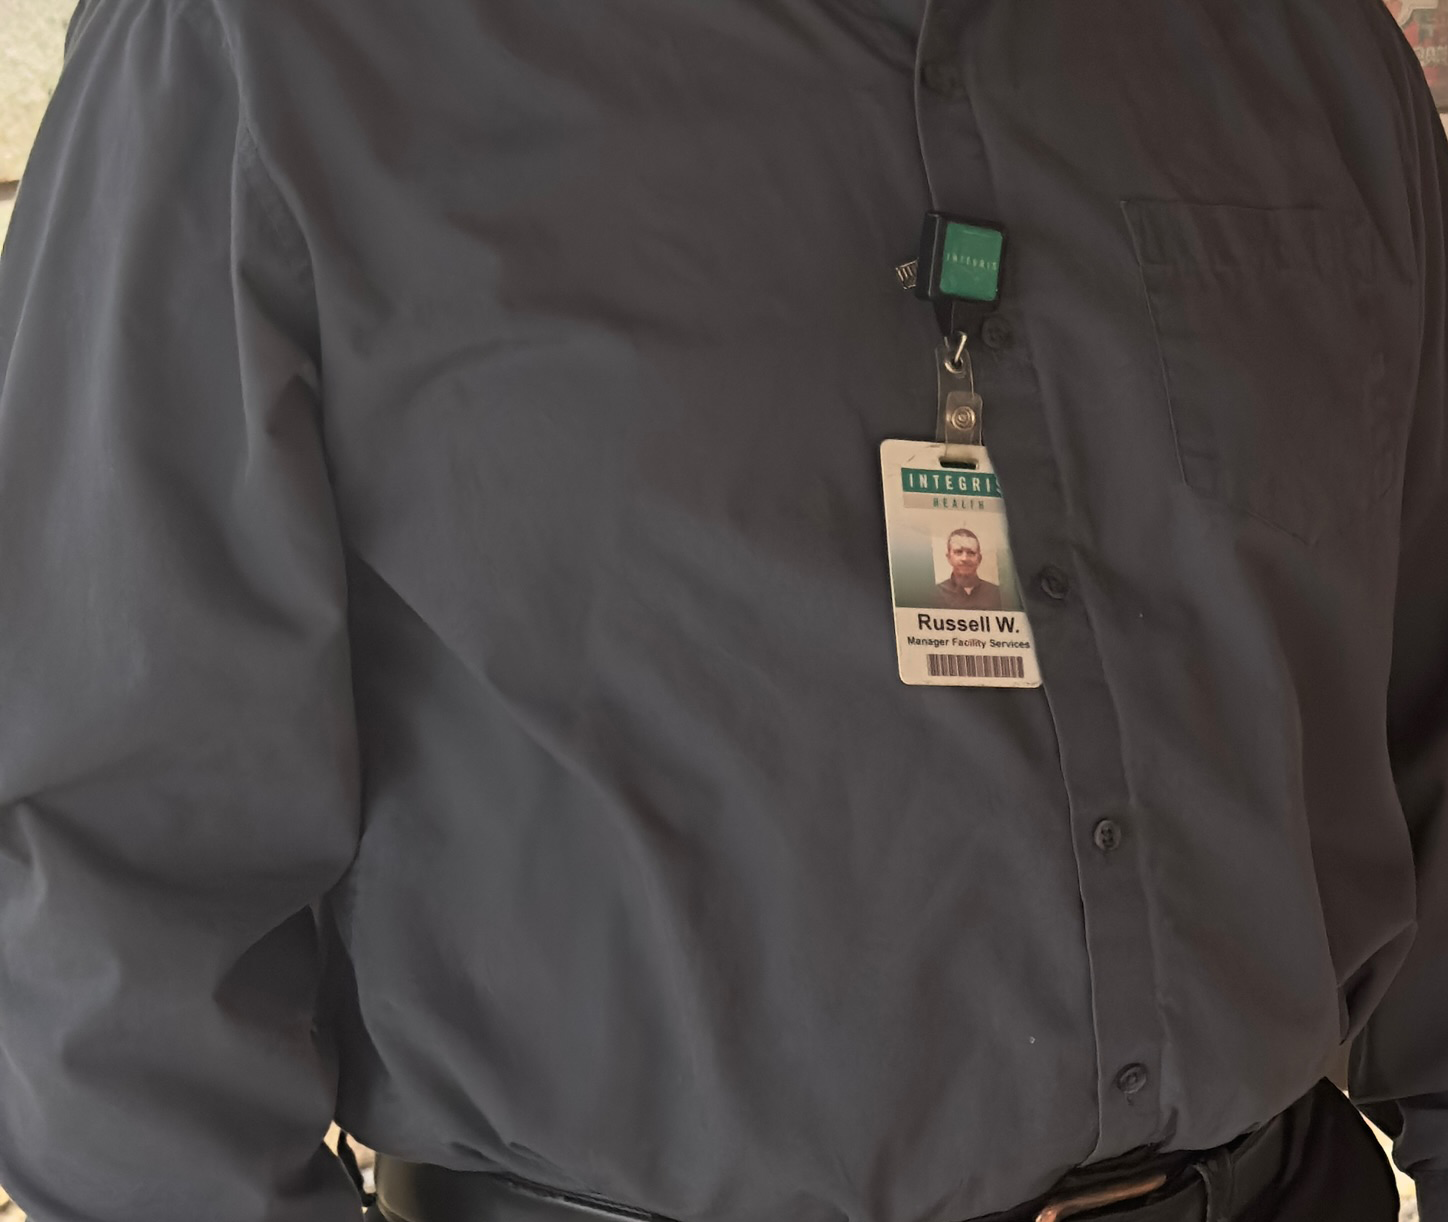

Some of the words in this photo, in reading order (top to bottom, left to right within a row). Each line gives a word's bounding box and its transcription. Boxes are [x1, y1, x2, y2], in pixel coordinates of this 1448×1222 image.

[933, 497, 985, 510] HEALTH
[917, 613, 991, 633] Russell
[995, 615, 1020, 634] W.
[907, 636, 949, 648] Manager
[952, 637, 987, 649] Facility
[990, 639, 1031, 649] Services
